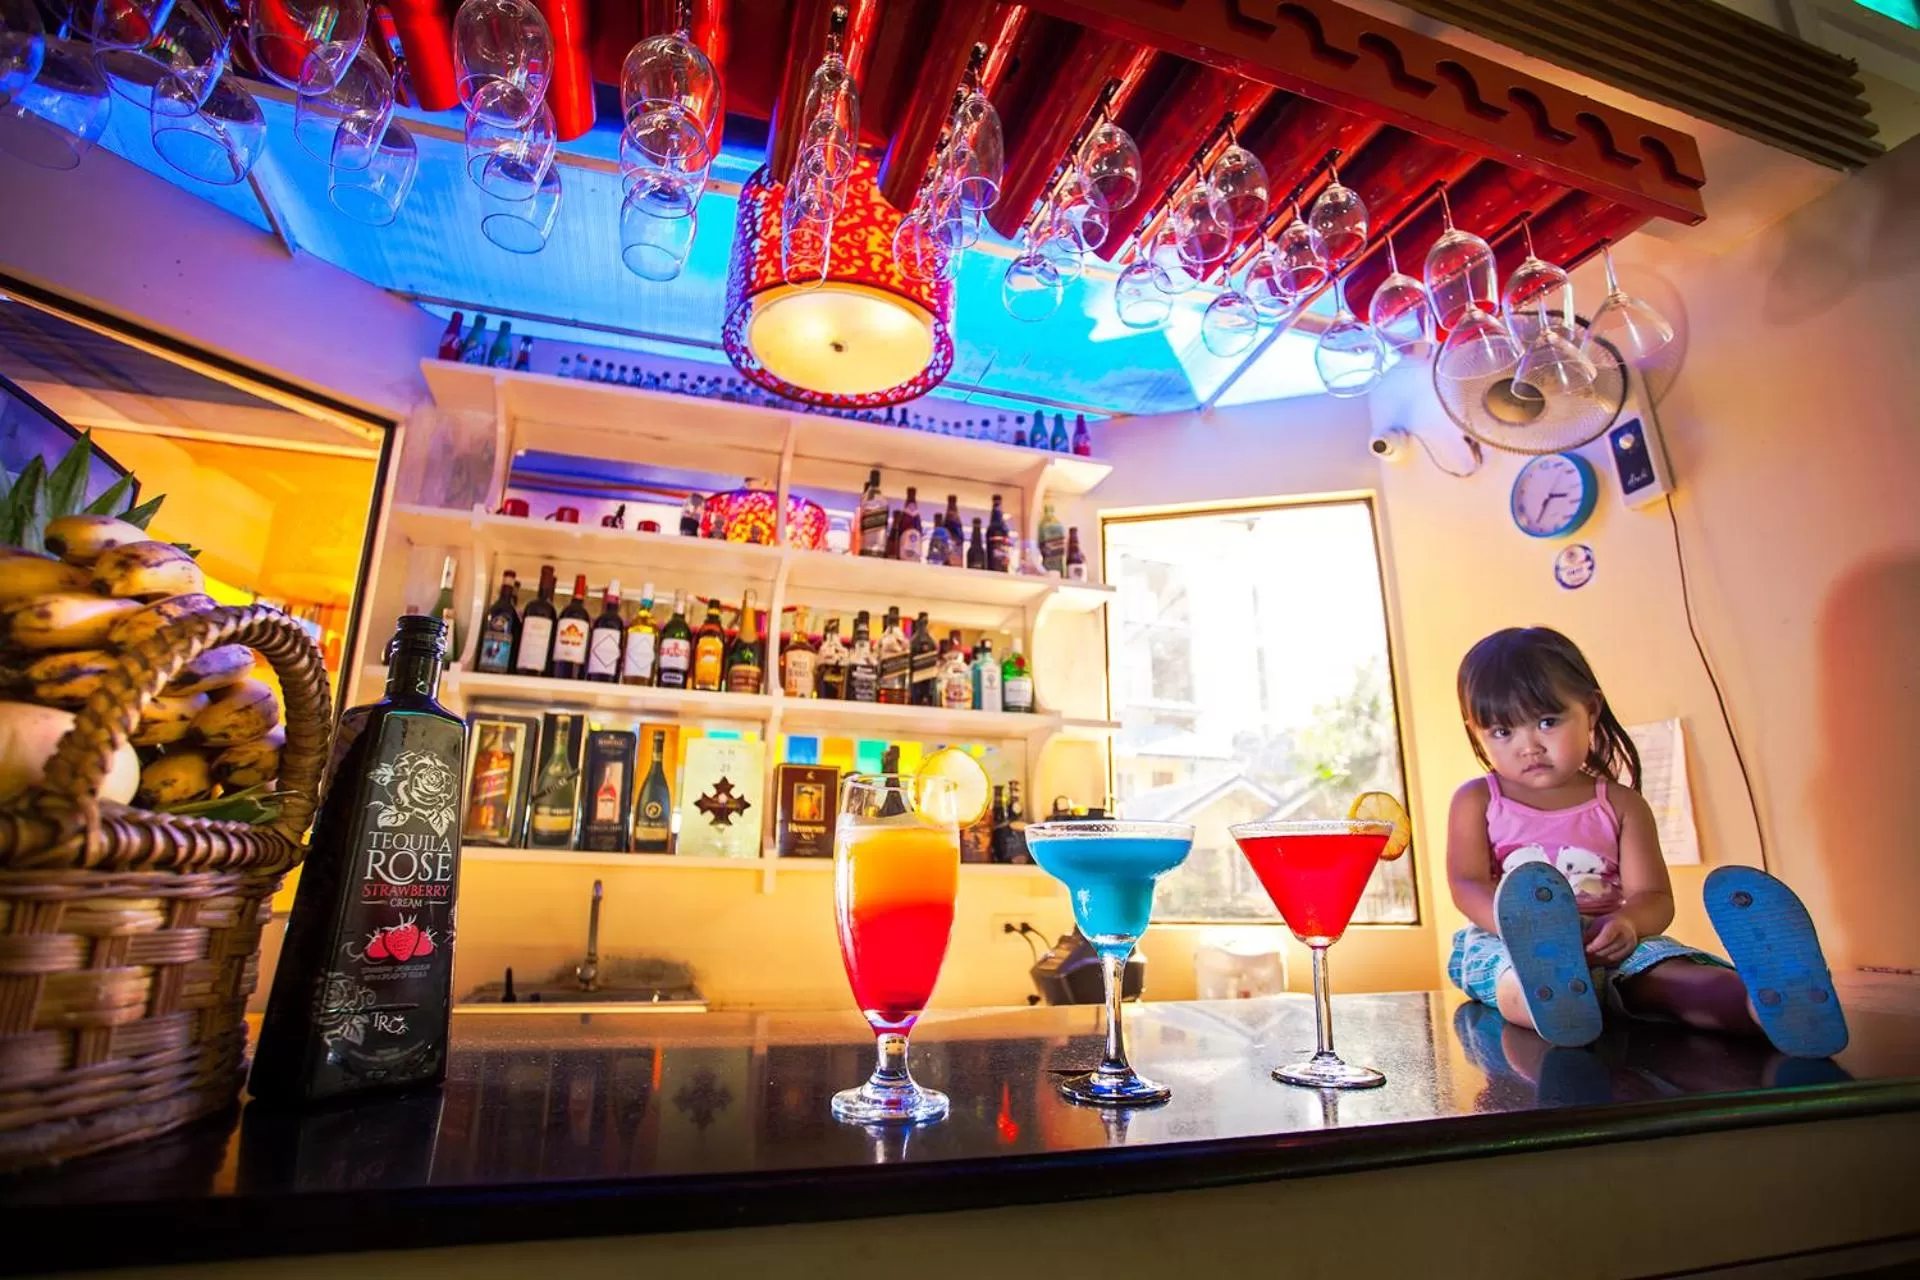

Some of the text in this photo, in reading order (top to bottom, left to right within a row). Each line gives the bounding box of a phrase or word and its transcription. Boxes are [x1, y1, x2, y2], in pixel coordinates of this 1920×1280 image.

[368, 831, 451, 852] TEQUILA
[364, 850, 452, 885] ROSE
[362, 884, 449, 897] STRAWBERRY
[390, 898, 423, 908] CREAM
